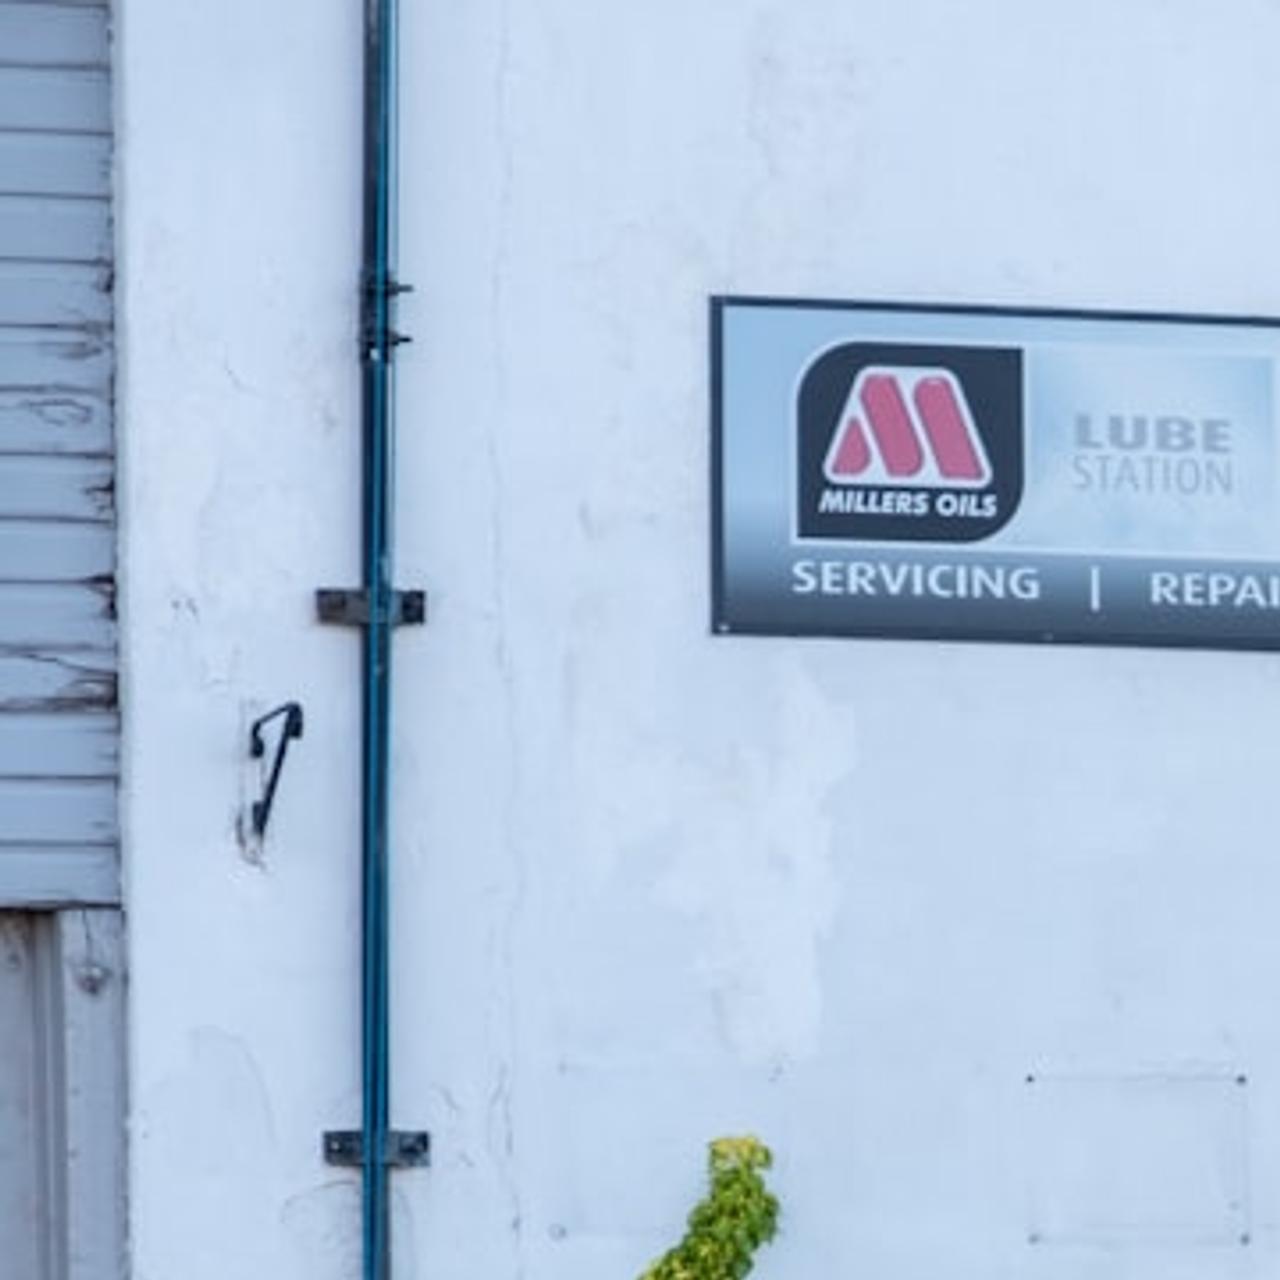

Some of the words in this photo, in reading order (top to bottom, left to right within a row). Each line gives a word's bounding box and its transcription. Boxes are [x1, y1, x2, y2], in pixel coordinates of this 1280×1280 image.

[1075, 414, 1232, 454] LUBE
[1073, 456, 1232, 495] STATION
[819, 491, 928, 516] MILLERS
[936, 494, 998, 518] OILS
[792, 561, 1041, 599] SERVICING
